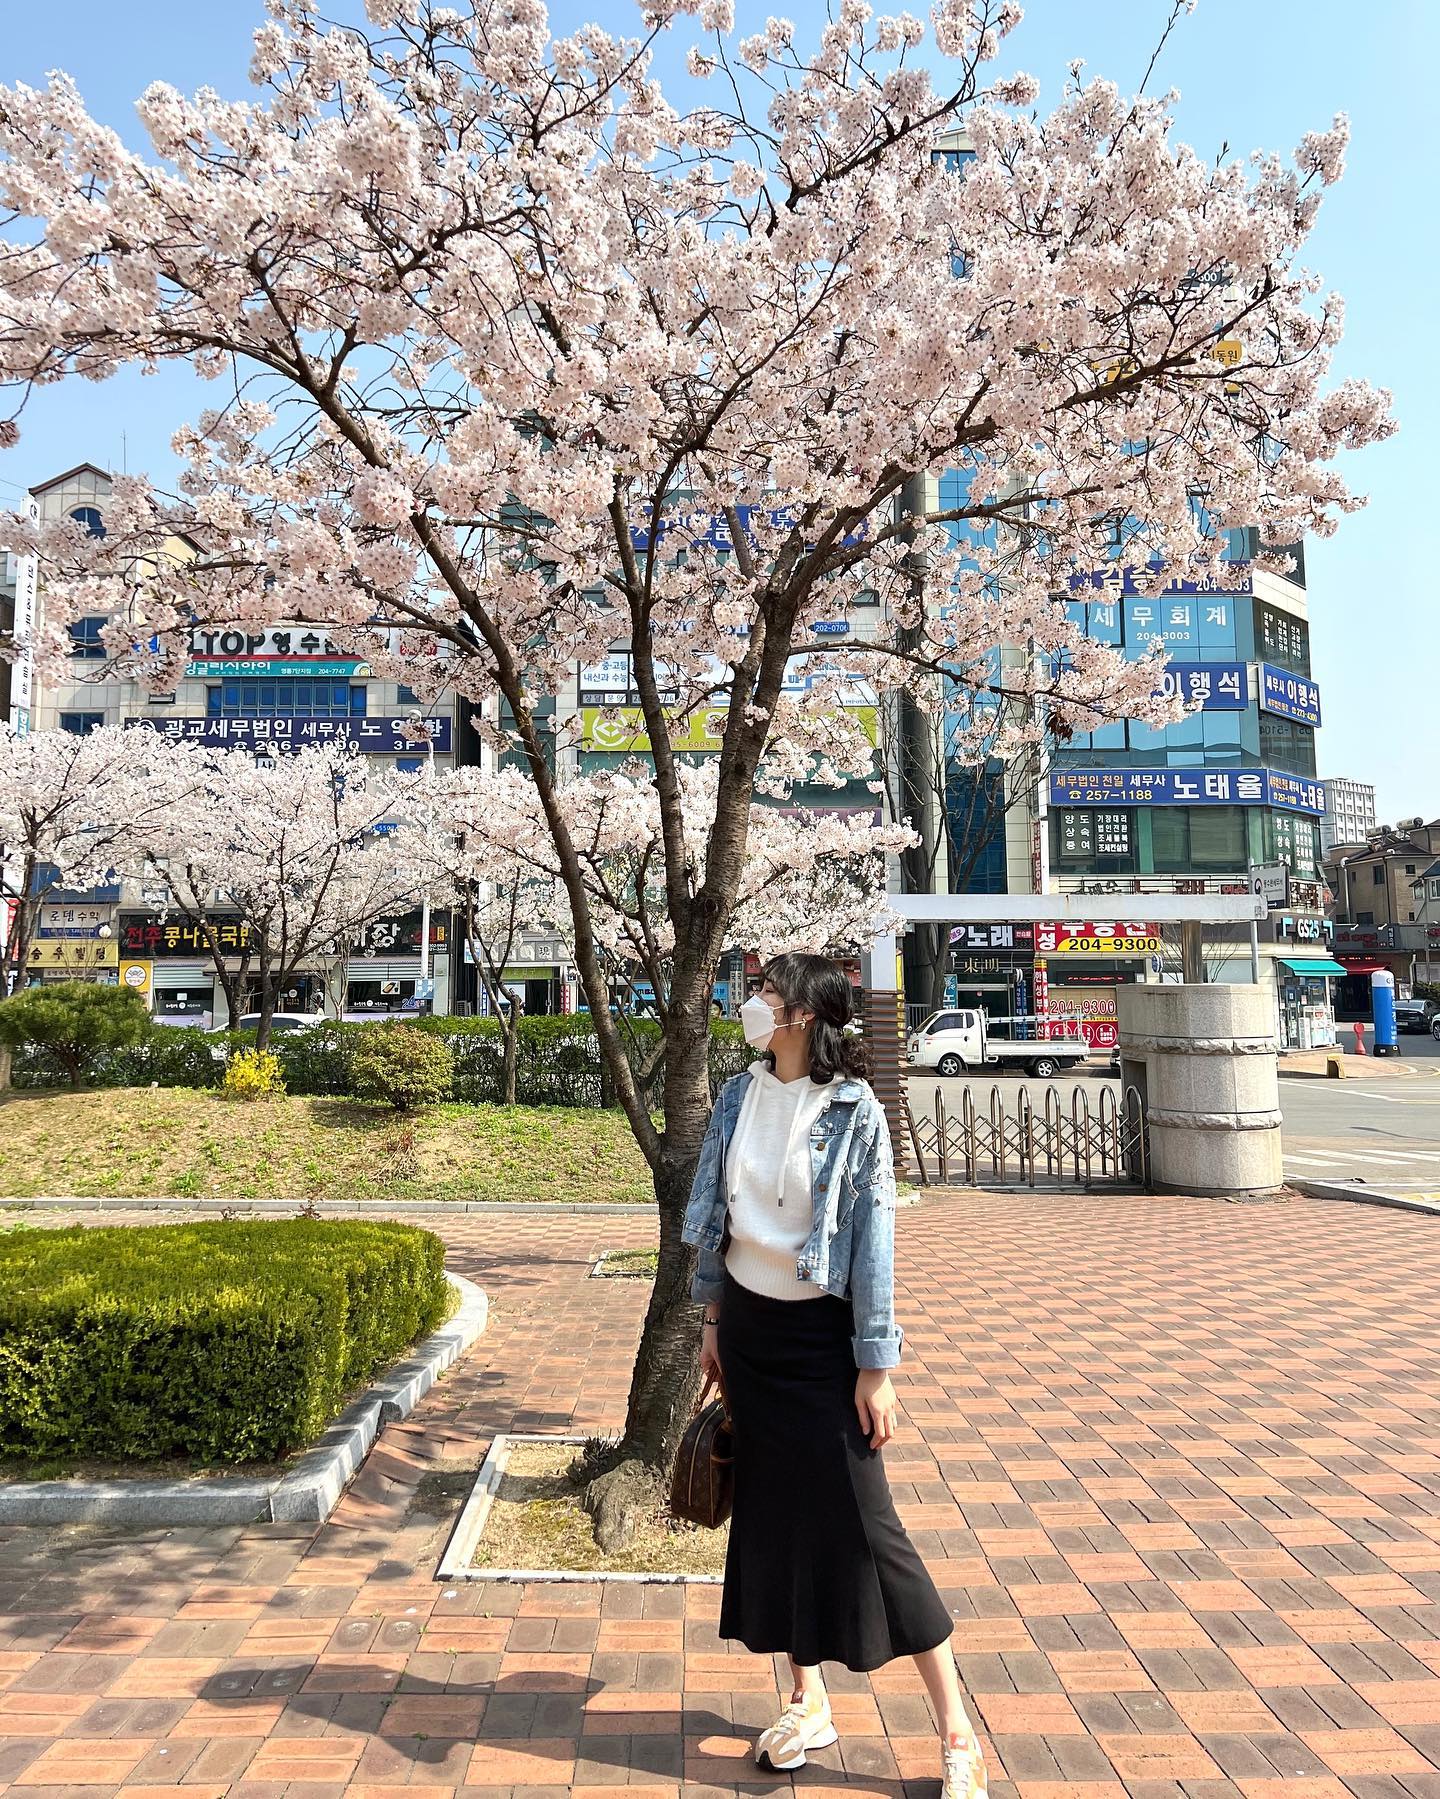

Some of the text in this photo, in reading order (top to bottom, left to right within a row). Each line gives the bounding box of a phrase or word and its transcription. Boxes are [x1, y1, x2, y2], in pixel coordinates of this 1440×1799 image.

[1161, 671, 1241, 700] 이행석
[1287, 680, 1318, 712] 이행석
[164, 718, 293, 739] 광교세무법인
[300, 721, 351, 738] 세무사
[393, 740, 415, 750] 3F
[1056, 774, 1262, 799] 세무법인 천일 세무사 노태율
[1086, 790, 1153, 800] 257-1188
[967, 925, 1013, 947] 노래
[1297, 918, 1320, 938] GS25
[1068, 938, 1158, 951] 204-9300
[1050, 1000, 1116, 1014] 204-9300
